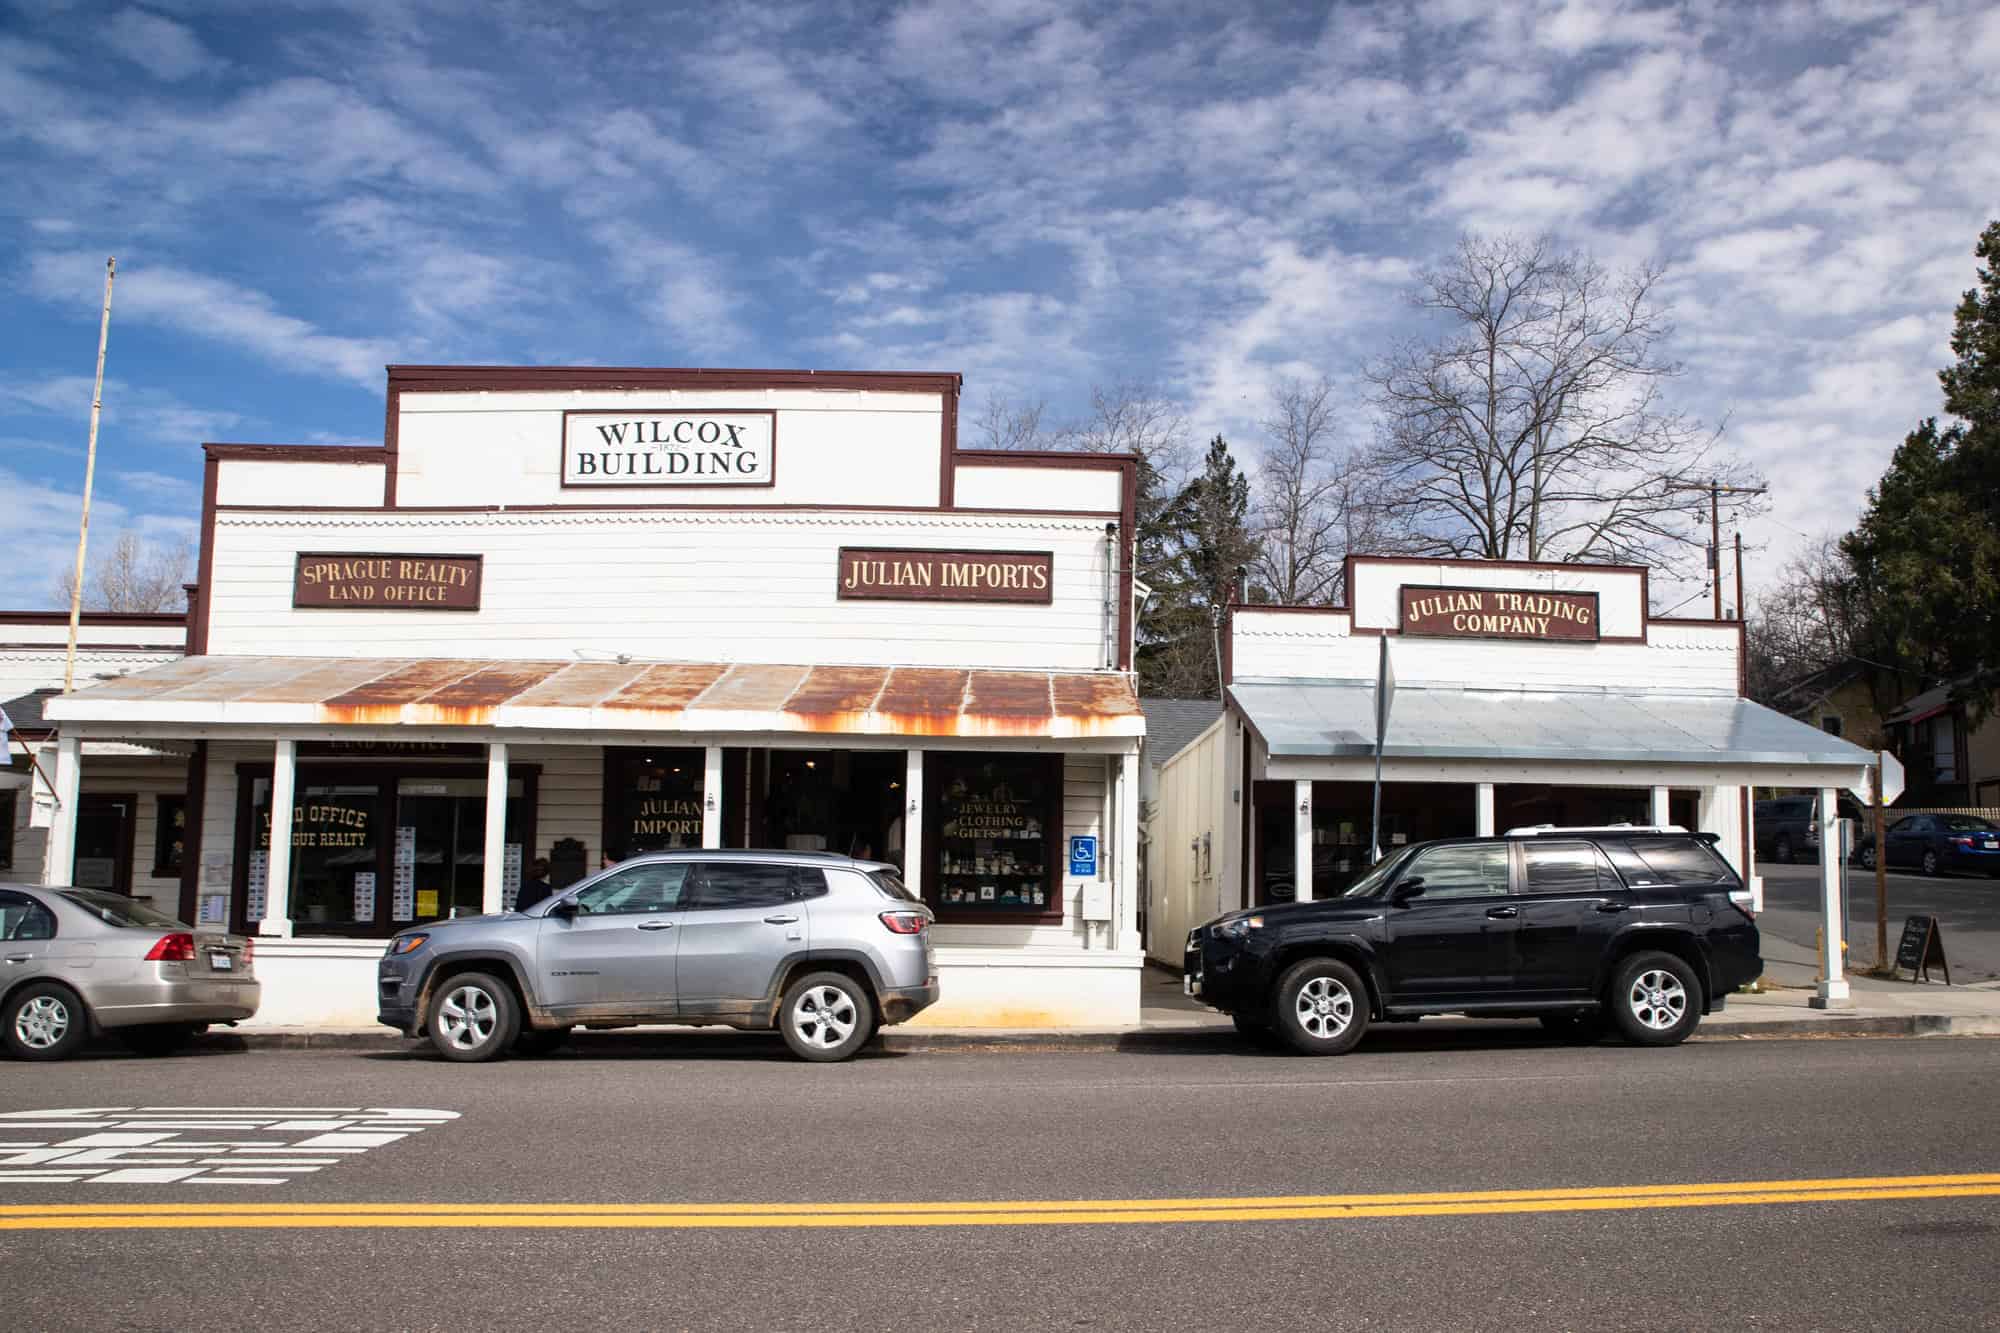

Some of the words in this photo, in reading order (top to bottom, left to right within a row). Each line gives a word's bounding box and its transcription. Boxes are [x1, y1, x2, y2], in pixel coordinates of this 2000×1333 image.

[596, 420, 747, 449] WILCOX
[577, 451, 759, 475] BUILDING
[303, 560, 393, 585] SPRAGUE
[399, 560, 472, 587] REALTY
[845, 561, 933, 589] JULIAN
[941, 562, 1048, 590] IMPORTS
[329, 585, 375, 600] LAND
[384, 585, 448, 601] OFFICE
[1409, 593, 1483, 622] JULIAN
[1495, 592, 1590, 625] TRADING
[1453, 614, 1550, 634] COMPANY
[310, 805, 368, 828] OFFICE
[641, 799, 704, 816] JULIAN
[633, 819, 702, 834] IMPORT
[959, 816, 1024, 827] CLOTHING
[261, 832, 317, 847] SGUE
[319, 832, 366, 847] REALTY
